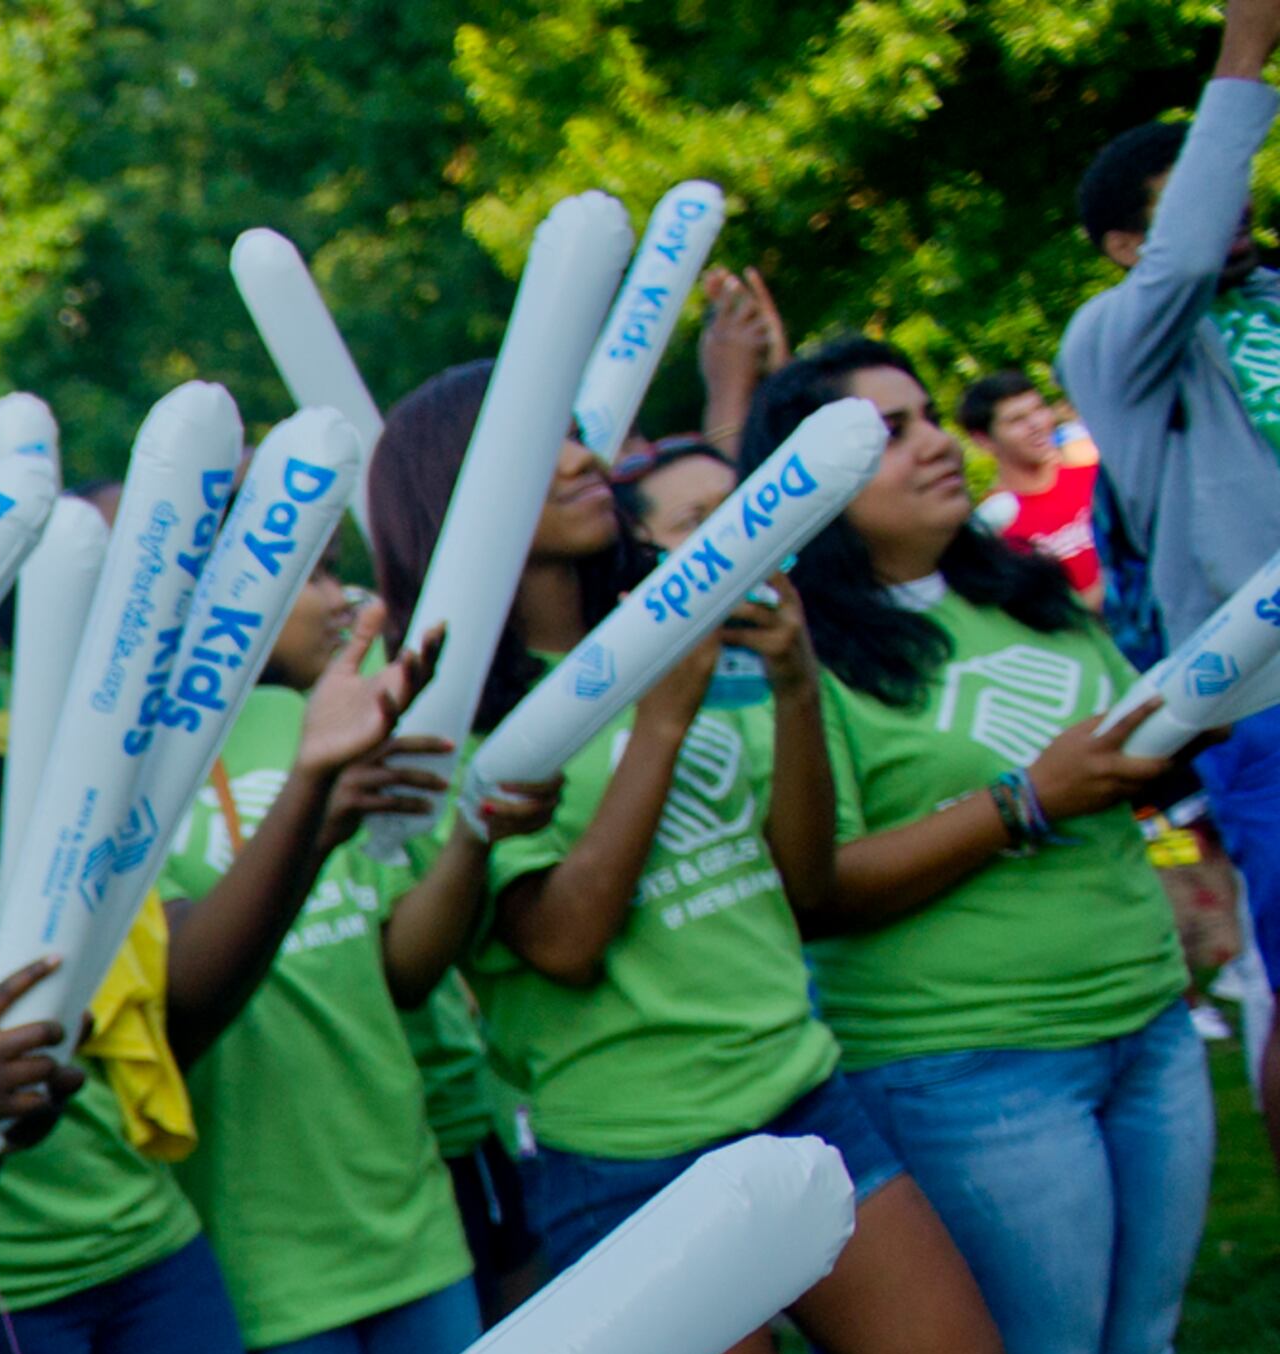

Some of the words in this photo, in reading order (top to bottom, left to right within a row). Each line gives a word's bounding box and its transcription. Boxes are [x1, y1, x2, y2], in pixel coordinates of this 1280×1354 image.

[656, 199, 707, 264] Day
[608, 285, 670, 361] Kids
[243, 457, 338, 577] Day
[741, 453, 818, 540] Day
[644, 538, 734, 623] Kids
[156, 605, 264, 733] Kids
